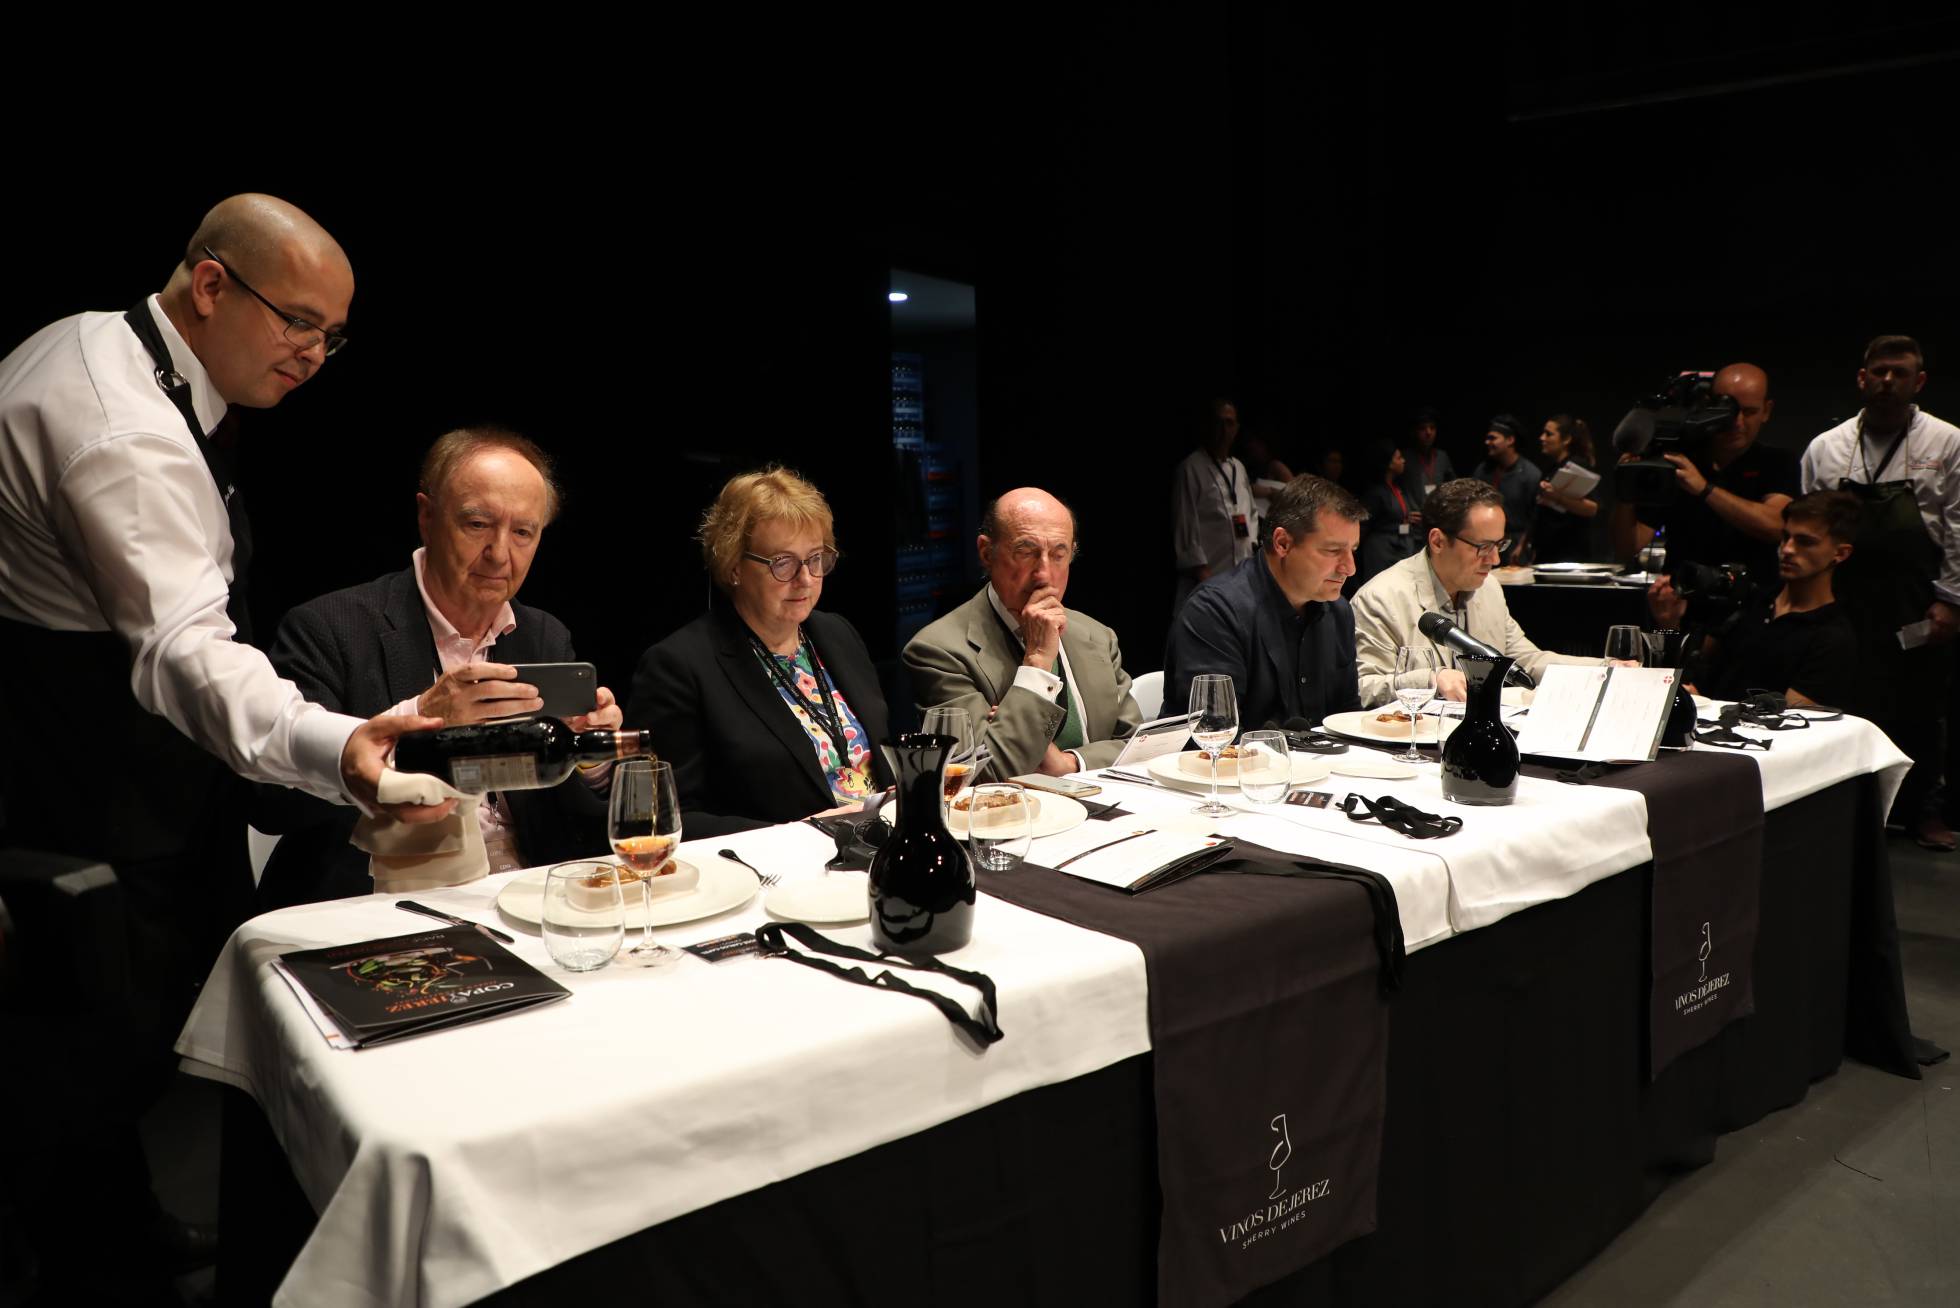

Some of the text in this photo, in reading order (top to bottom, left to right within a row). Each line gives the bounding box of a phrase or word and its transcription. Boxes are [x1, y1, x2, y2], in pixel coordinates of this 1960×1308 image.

[459, 982, 515, 997] COPA
[1219, 1178, 1331, 1244] VINOS DE JEREZ
[1242, 1210, 1307, 1250] SHERRY WINES
